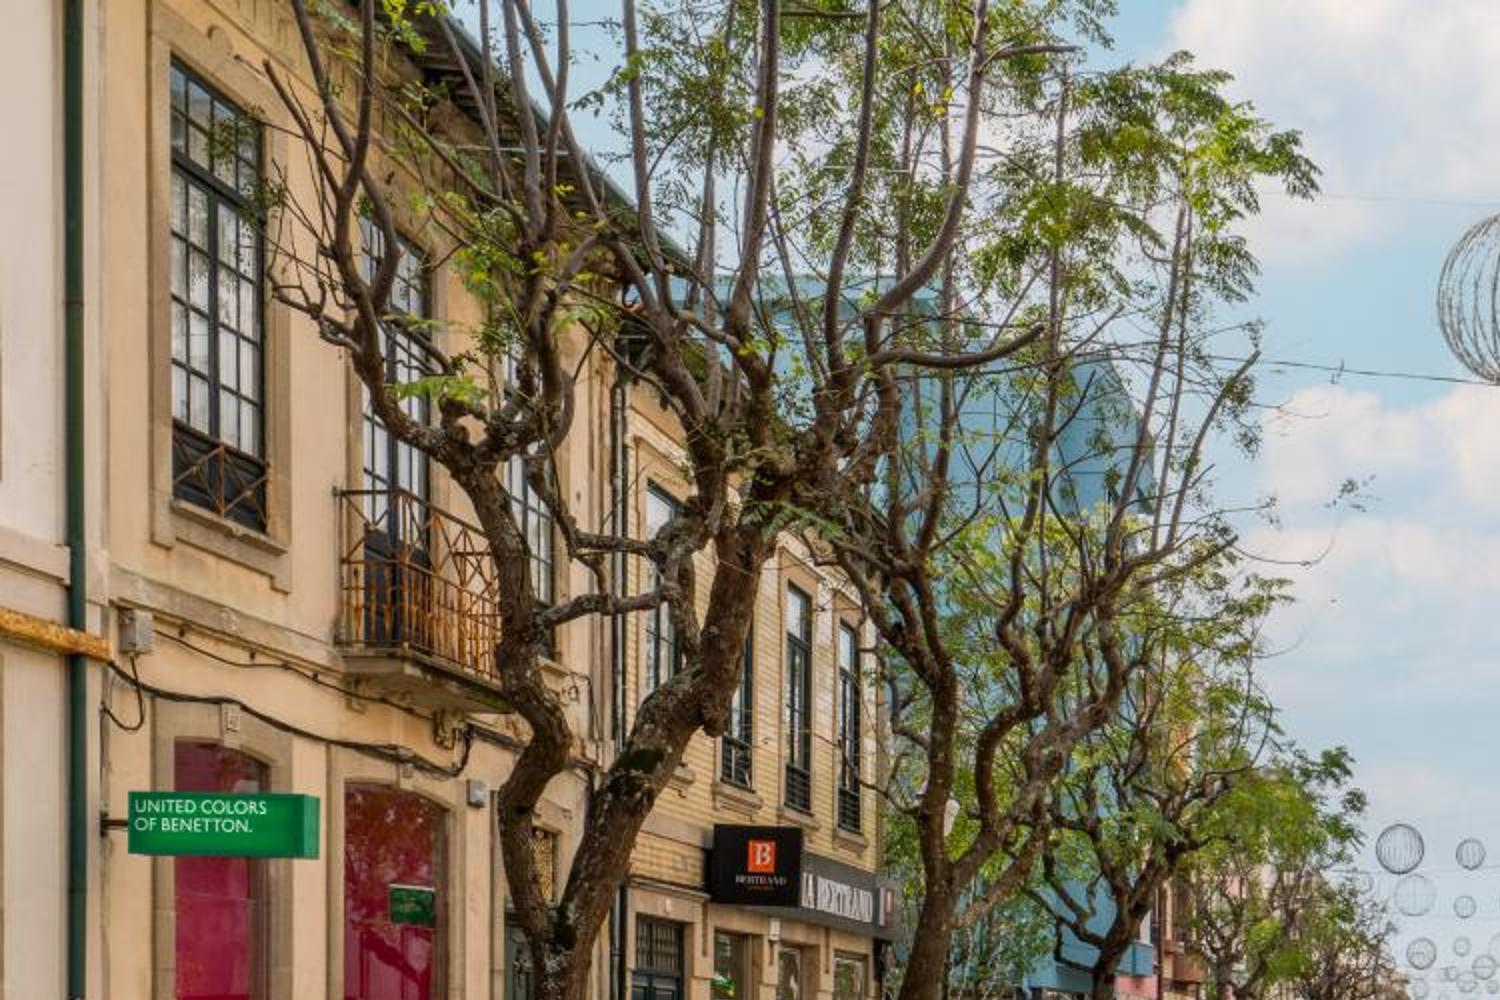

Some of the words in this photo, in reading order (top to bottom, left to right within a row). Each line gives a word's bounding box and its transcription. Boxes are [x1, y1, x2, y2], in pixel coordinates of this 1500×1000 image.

[135, 800, 197, 814] UNITED
[201, 800, 267, 815] COLORS
[134, 817, 157, 831] OF
[161, 818, 253, 833] BENETTON.
[754, 842, 772, 865] B
